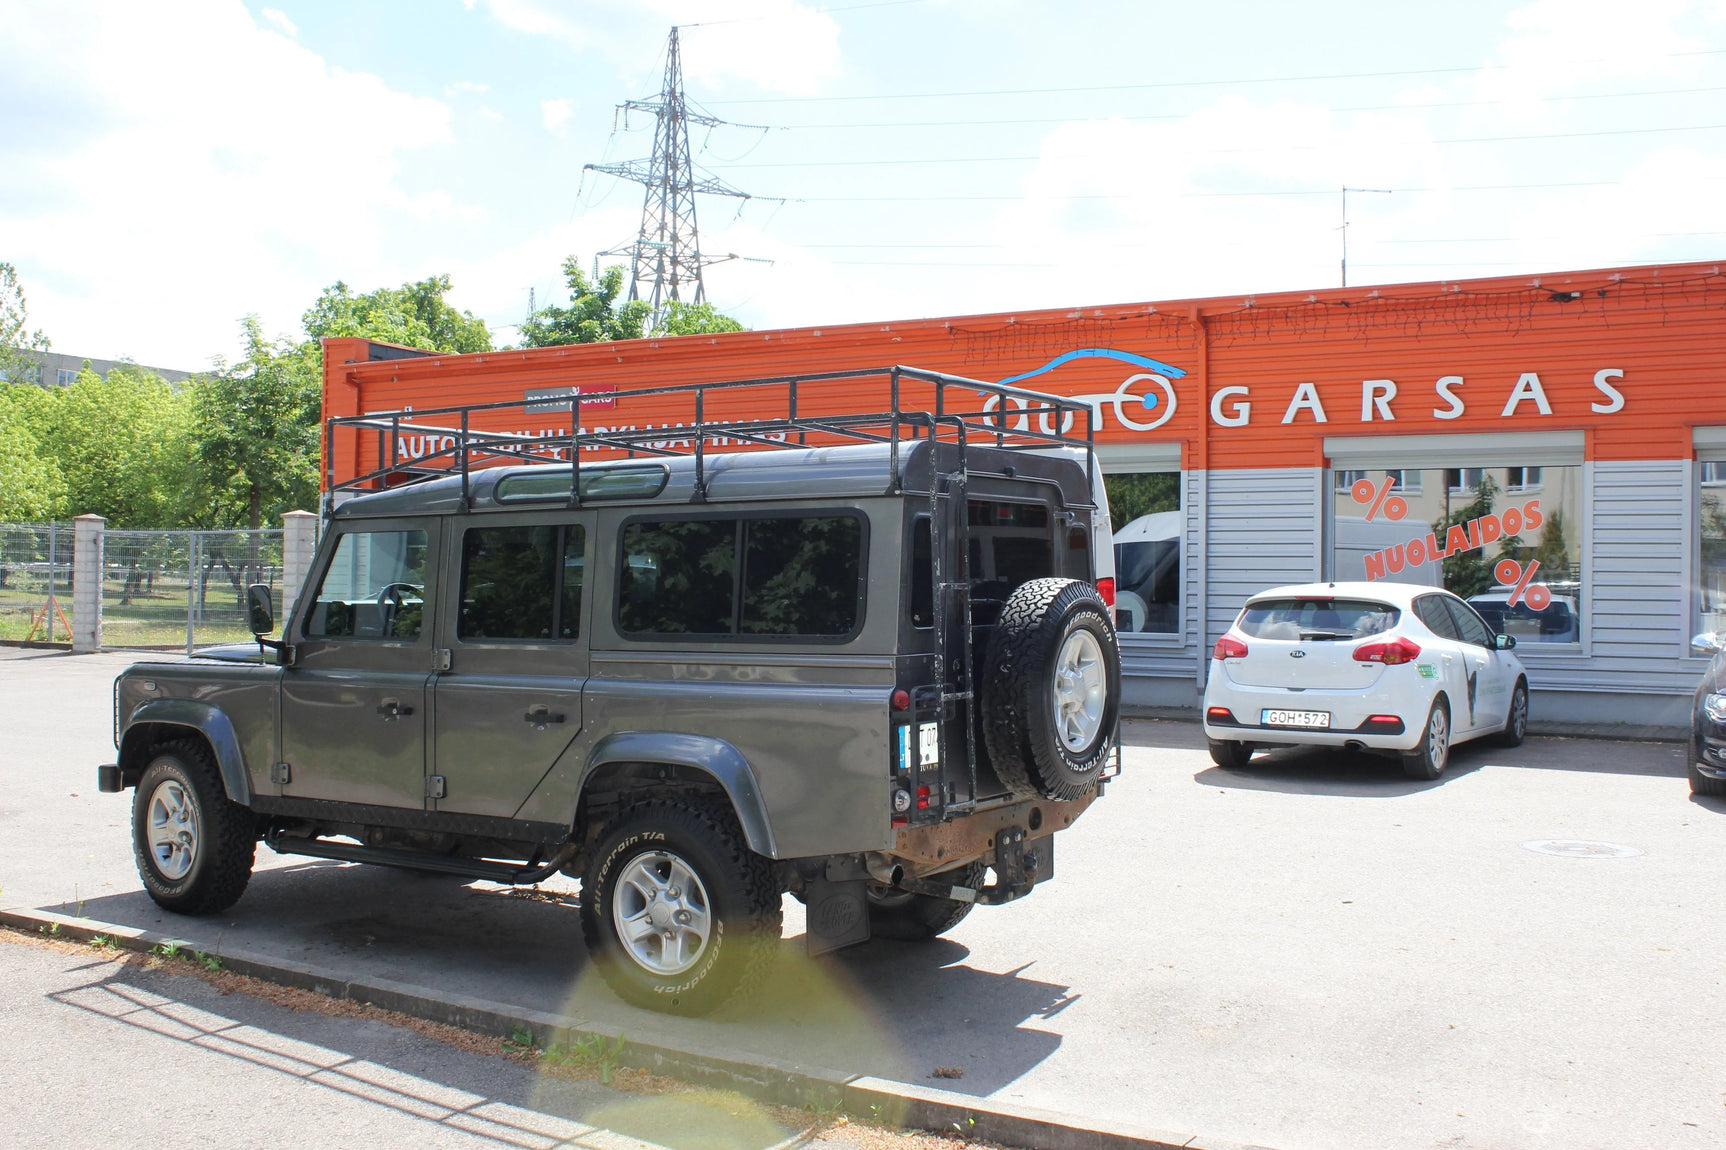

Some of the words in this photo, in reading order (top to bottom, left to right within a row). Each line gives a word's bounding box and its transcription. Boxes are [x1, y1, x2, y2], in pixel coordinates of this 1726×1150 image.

[1210, 368, 1625, 427] GARSAS
[1364, 500, 1544, 582] NUOLAIDOS
[1269, 711, 1296, 723] GOH
[1303, 713, 1327, 726] 572
